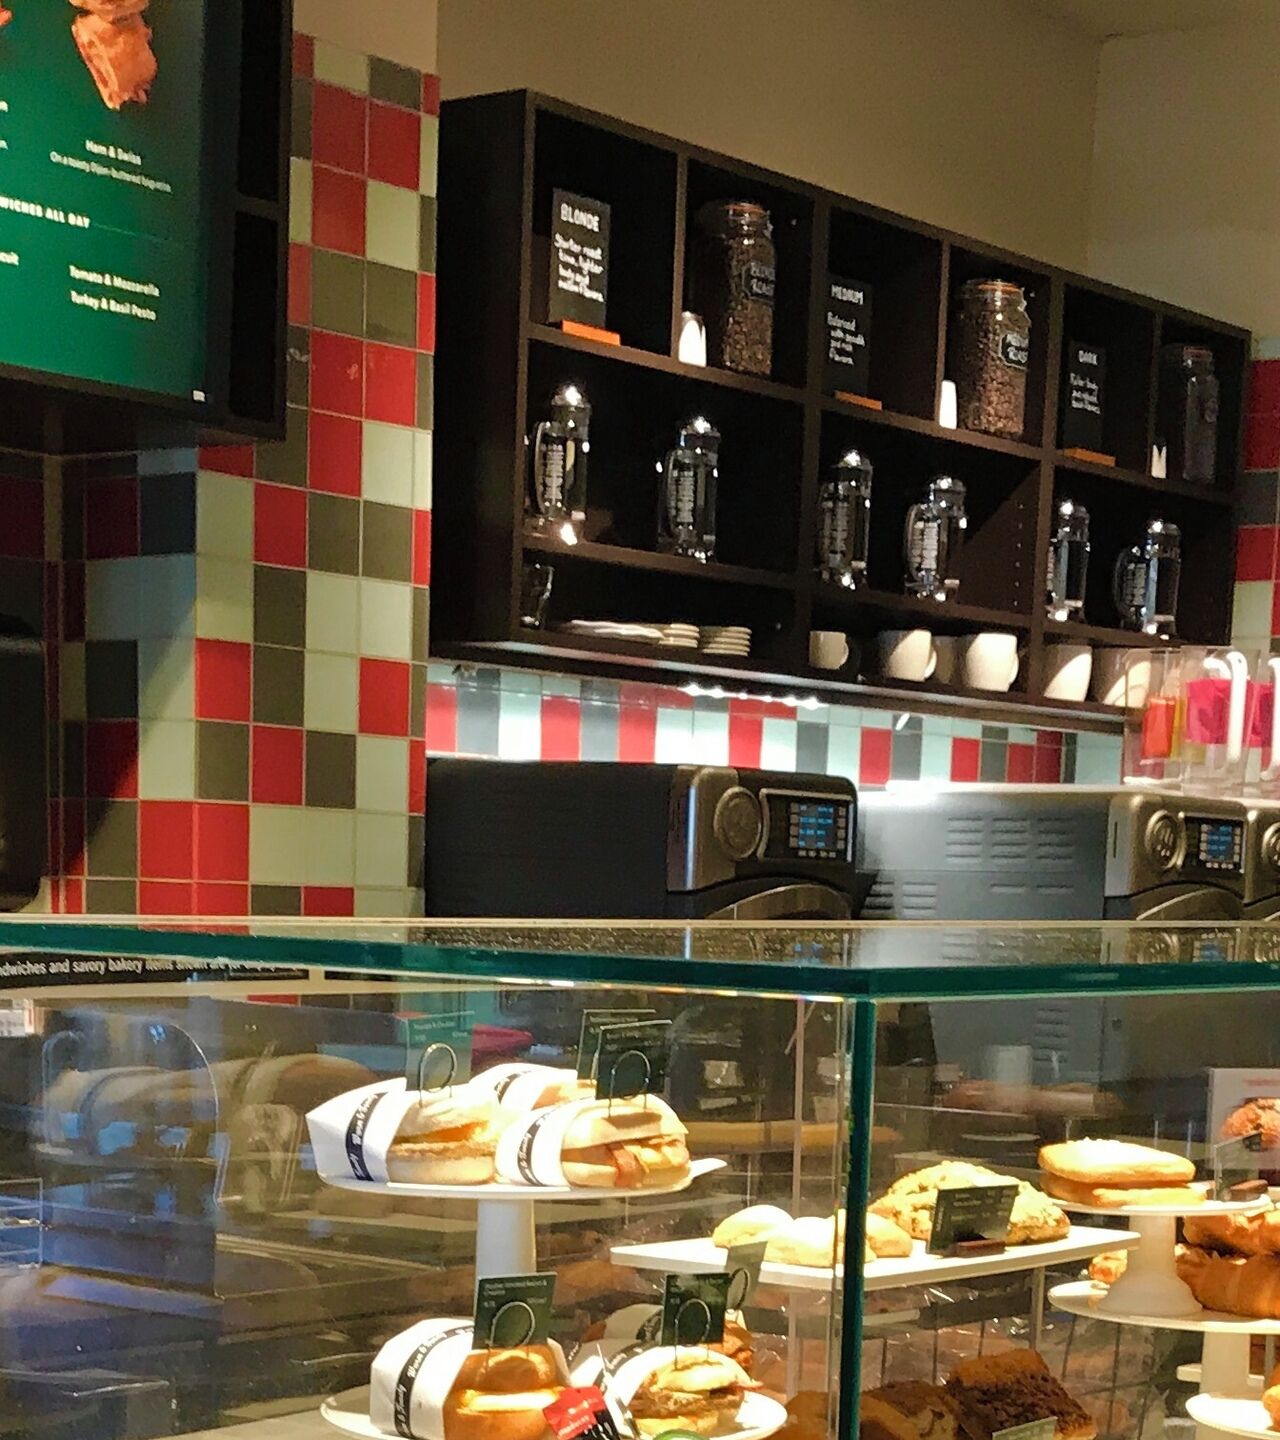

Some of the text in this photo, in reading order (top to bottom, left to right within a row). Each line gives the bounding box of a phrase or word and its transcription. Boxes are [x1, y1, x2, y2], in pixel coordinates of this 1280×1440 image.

[85, 139, 108, 156] Ham
[108, 145, 117, 158] &
[44, 207, 65, 223] ALL
[68, 212, 90, 229] DAY
[561, 203, 599, 232] BLONDE
[69, 265, 160, 297] Tomato & Mozzarella
[831, 284, 864, 305] MEDIUM
[70, 290, 156, 321] Turkey & Basil Pesto
[1078, 350, 1098, 366] DARK
[48, 958, 70, 974] and
[71, 959, 106, 975] savory
[107, 957, 144, 975] bakery
